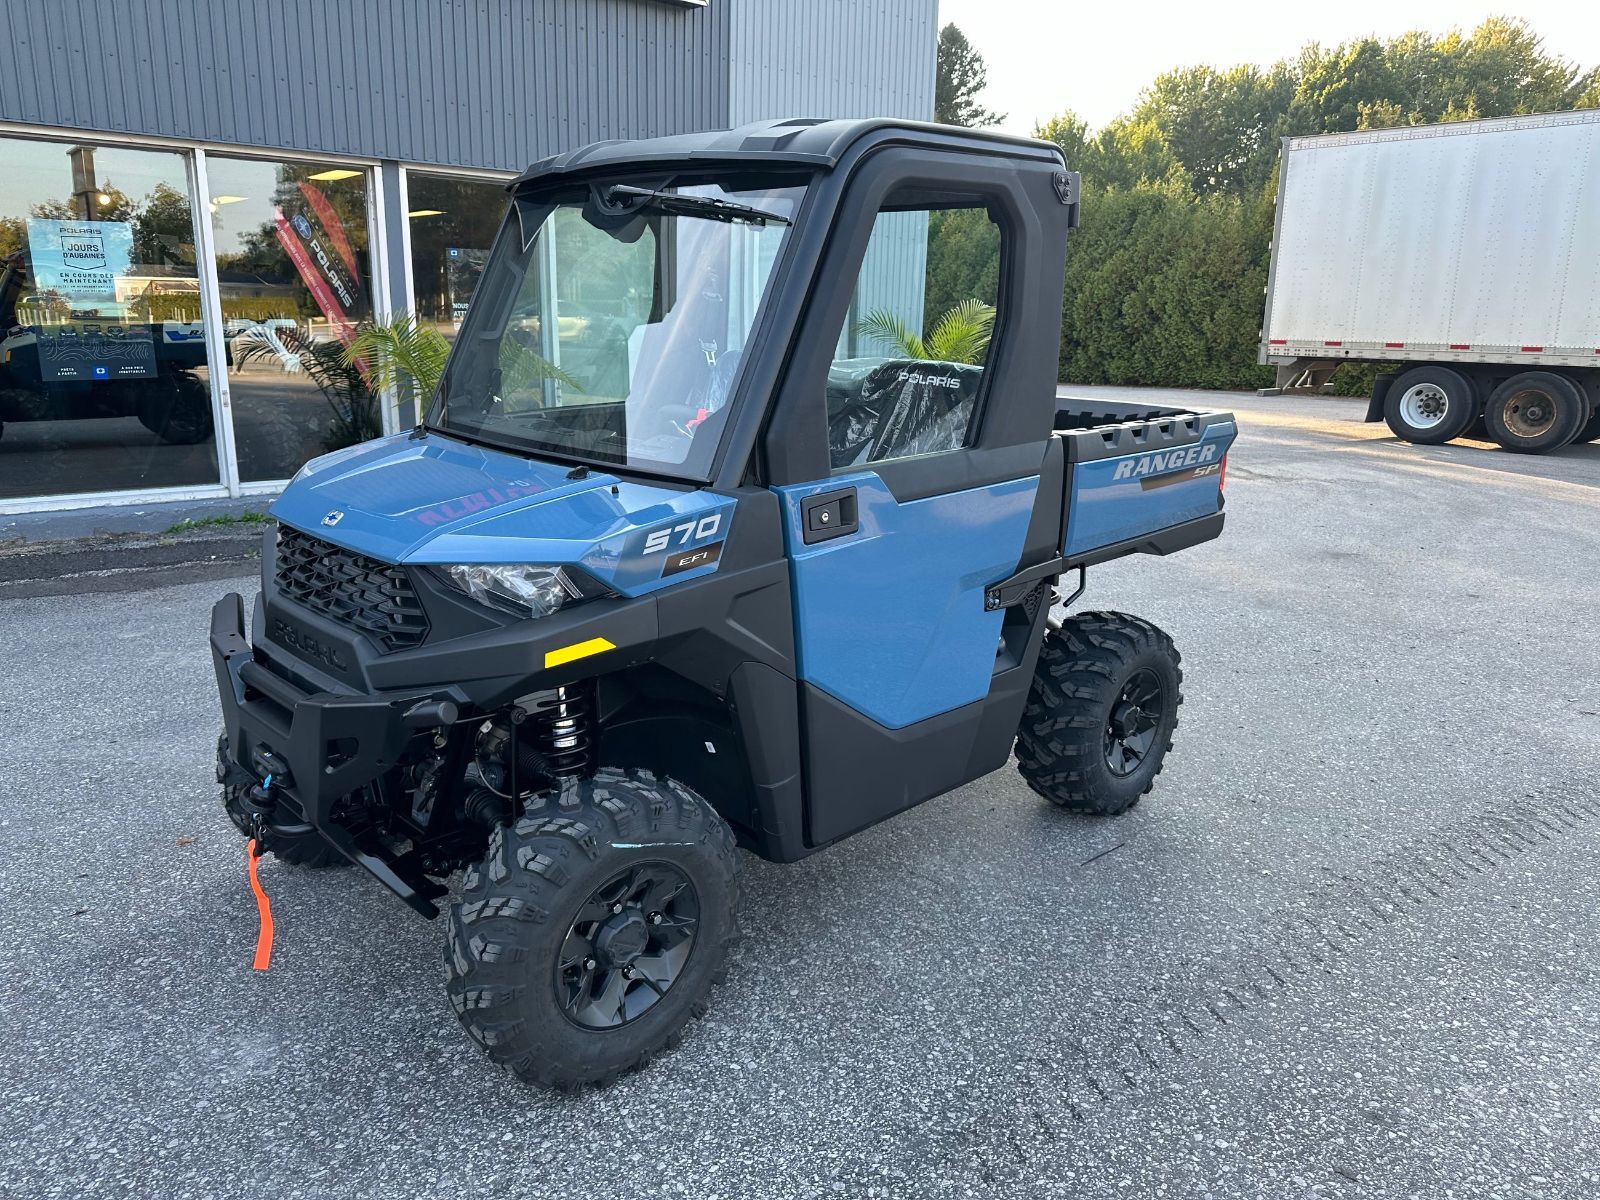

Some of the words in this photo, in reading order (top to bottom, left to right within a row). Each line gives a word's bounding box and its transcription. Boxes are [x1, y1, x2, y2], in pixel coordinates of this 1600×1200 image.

[60, 227, 102, 235] POLARIS
[63, 252, 105, 260] D'AUBAINES
[67, 244, 99, 252] JOURS
[310, 239, 353, 307] POLARIS
[898, 371, 961, 388] POLARIS
[1112, 444, 1216, 481] RANGER
[1191, 463, 1220, 479] SP
[643, 513, 722, 555] 570
[678, 551, 709, 567] EFI
